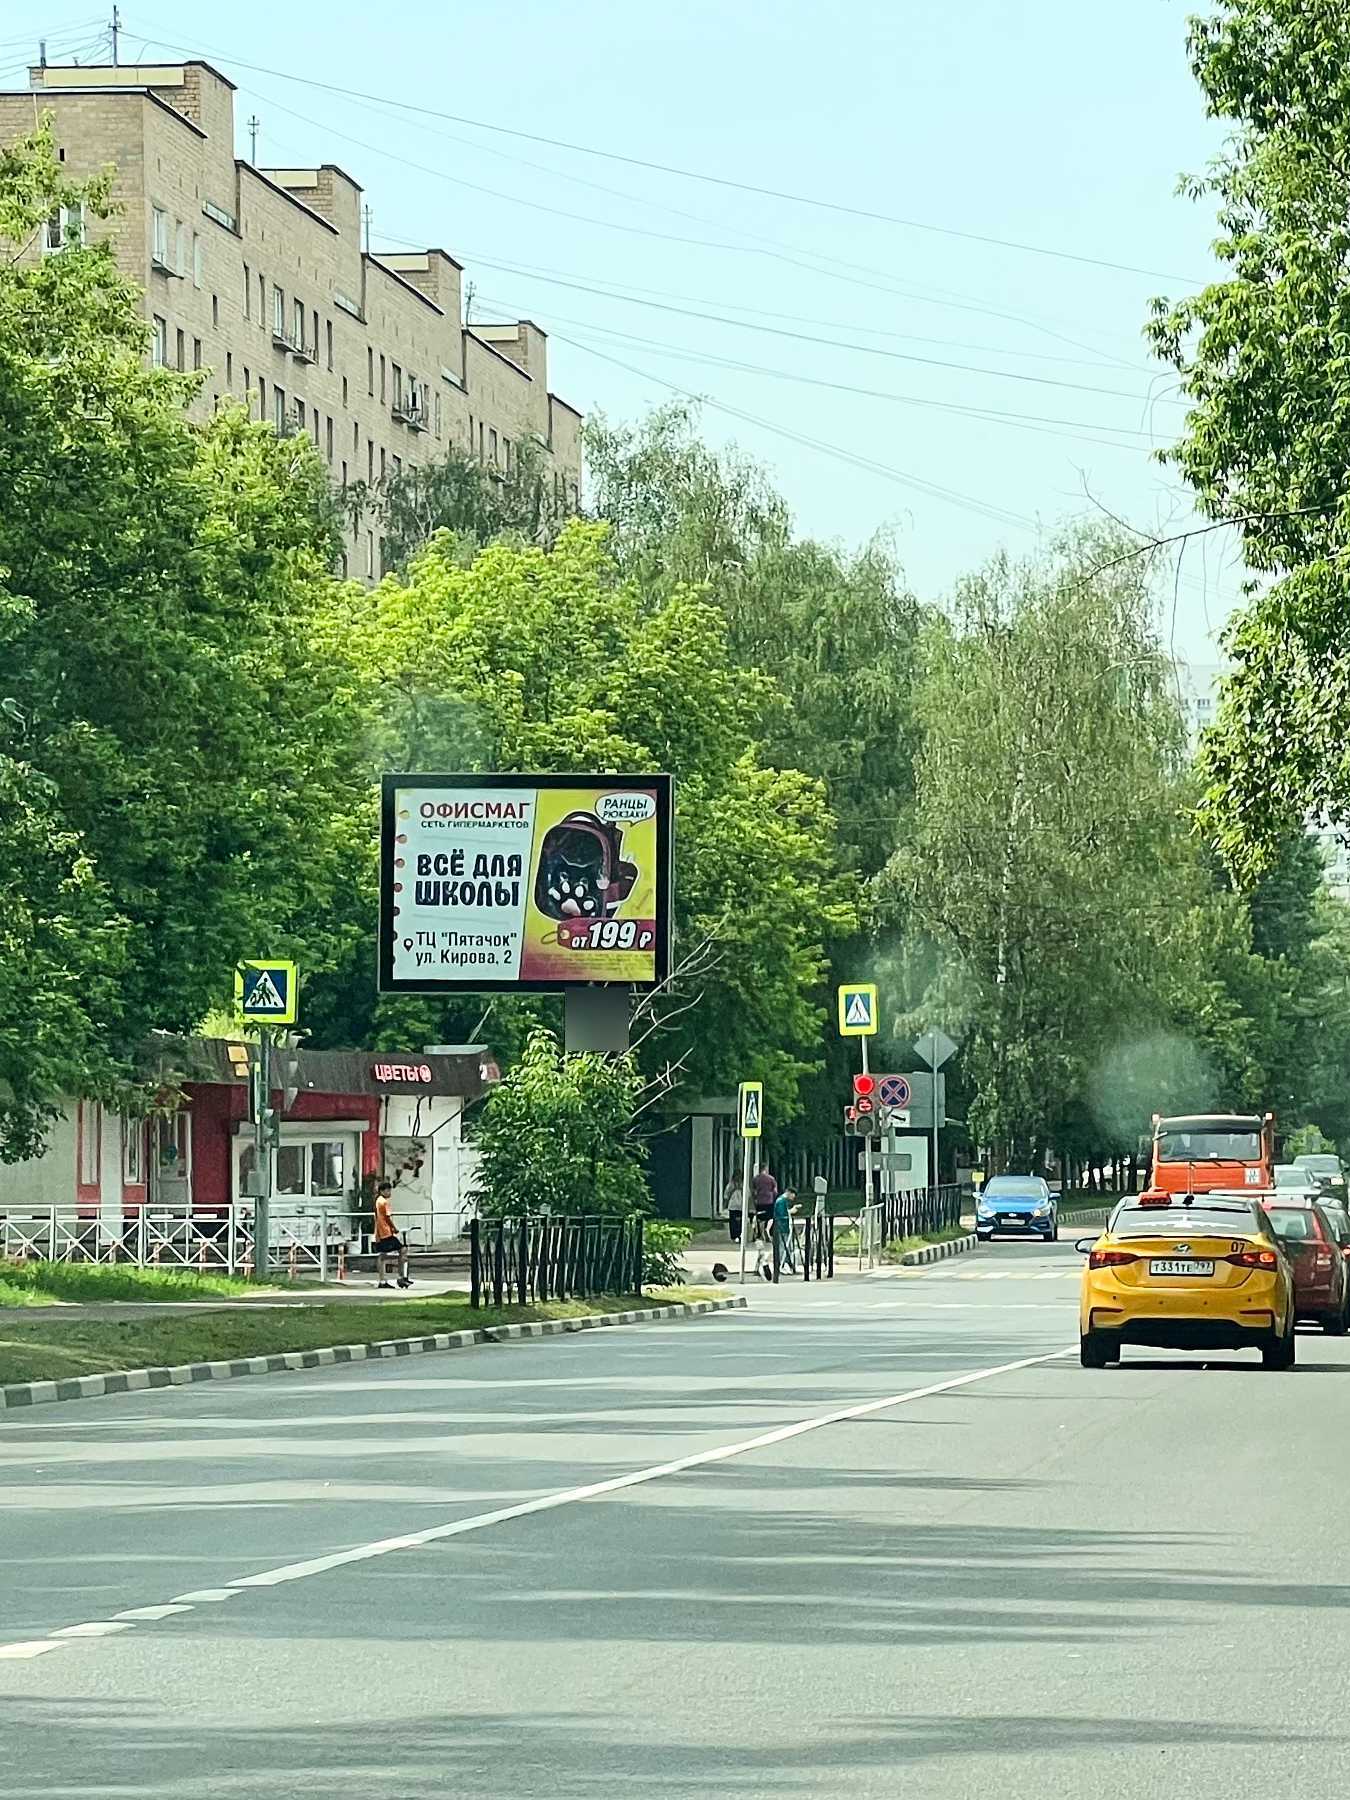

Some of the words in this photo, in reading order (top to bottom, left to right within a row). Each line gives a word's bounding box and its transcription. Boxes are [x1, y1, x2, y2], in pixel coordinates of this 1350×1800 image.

[420, 802, 530, 819] ОФИСМАГ
[604, 799, 648, 810] РАНЦЫ
[603, 810, 648, 819] РЮКЗАКИ
[421, 820, 445, 829] СЕТЬ
[447, 820, 529, 829] ГИПЕРМАРКЕТОВ
[417, 848, 465, 877] ВСЁ
[472, 854, 522, 879] ДЛЯ
[415, 880, 520, 907] ШКОЛЫ
[415, 931, 436, 949] ТЦ
[441, 931, 517, 947] "Пятачок"
[589, 921, 637, 949] 199
[415, 952, 436, 967] ул.
[440, 949, 499, 967] Кирова,
[503, 949, 512, 964] 2
[374, 1063, 420, 1083] ЦВЕТЫ
[1230, 1241, 1246, 1254] 07
